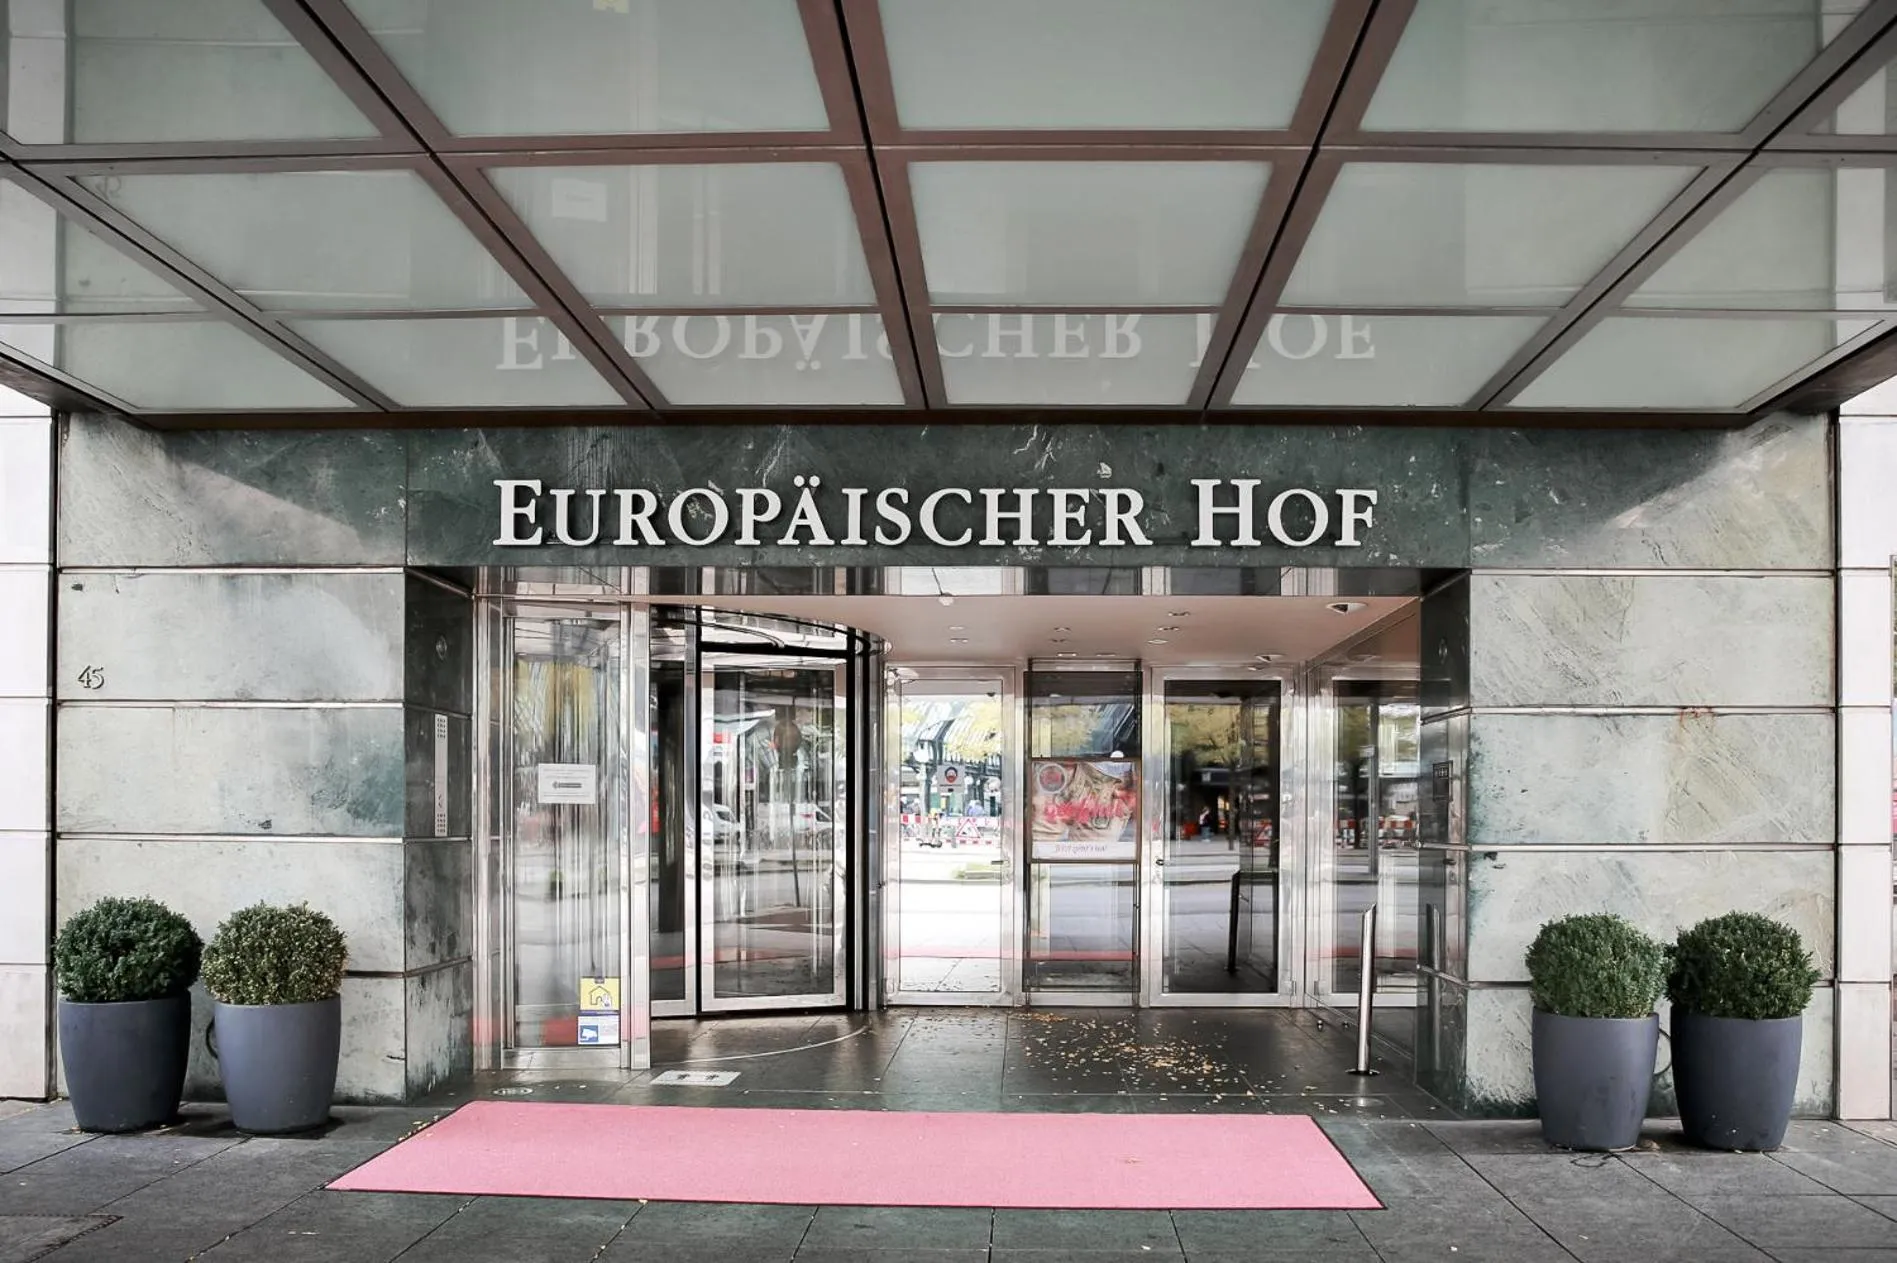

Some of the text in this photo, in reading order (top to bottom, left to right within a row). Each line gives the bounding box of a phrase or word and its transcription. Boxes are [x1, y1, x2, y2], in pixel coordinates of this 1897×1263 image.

[493, 475, 1378, 547] EUROPÄISCHER HOF
[77, 664, 105, 690] 45
